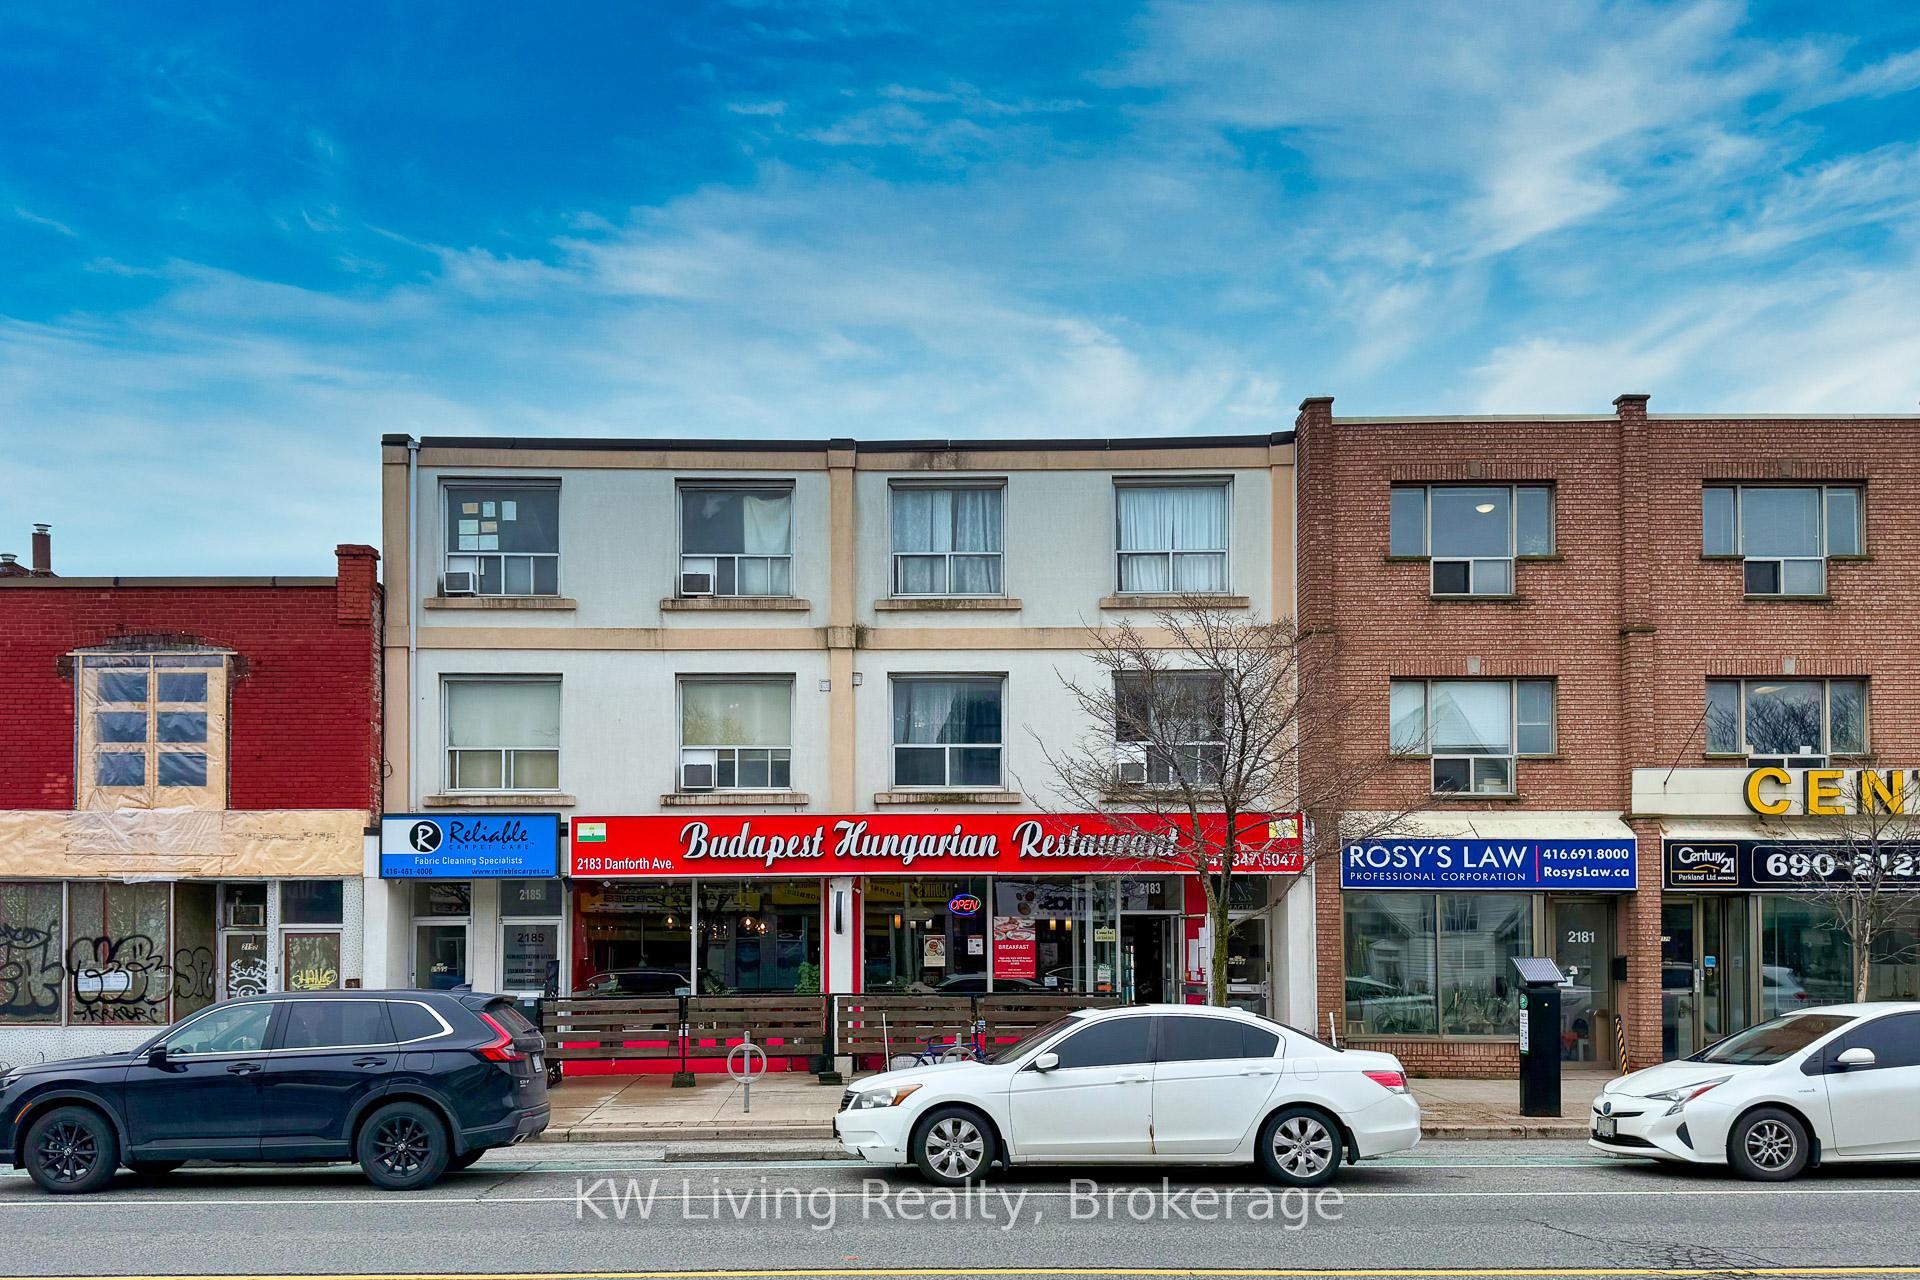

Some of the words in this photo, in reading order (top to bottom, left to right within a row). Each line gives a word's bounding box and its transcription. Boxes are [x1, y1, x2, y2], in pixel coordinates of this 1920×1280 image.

[449, 820, 528, 843] Reliable
[680, 821, 824, 867] Budapest
[833, 819, 999, 866] Hungarian
[1012, 820, 1181, 859] Restaurant
[1350, 846, 1451, 869] ROSY'S
[1463, 846, 1528, 868] LAW
[1543, 849, 1629, 860] 416.691.8000
[1678, 847, 1726, 864] Century
[1720, 857, 1735, 874] 21
[415, 857, 440, 865] Fabric
[442, 857, 477, 866] Cleaning
[479, 857, 523, 866] Specialists
[577, 858, 602, 870] 2183
[604, 858, 650, 870] Danforth
[652, 858, 675, 870] Ave.
[471, 868, 550, 876] www.reliablecarpet.ca
[1350, 872, 1436, 881] PROFESSIONAL
[1441, 872, 1526, 881] CORPORATION
[1544, 866, 1630, 878] RosysLaw.ca
[519, 889, 541, 900] 2185
[1139, 883, 1161, 895] 2183
[951, 900, 979, 911] OPEN
[518, 933, 544, 942] 2185
[1567, 931, 1595, 943] 2181
